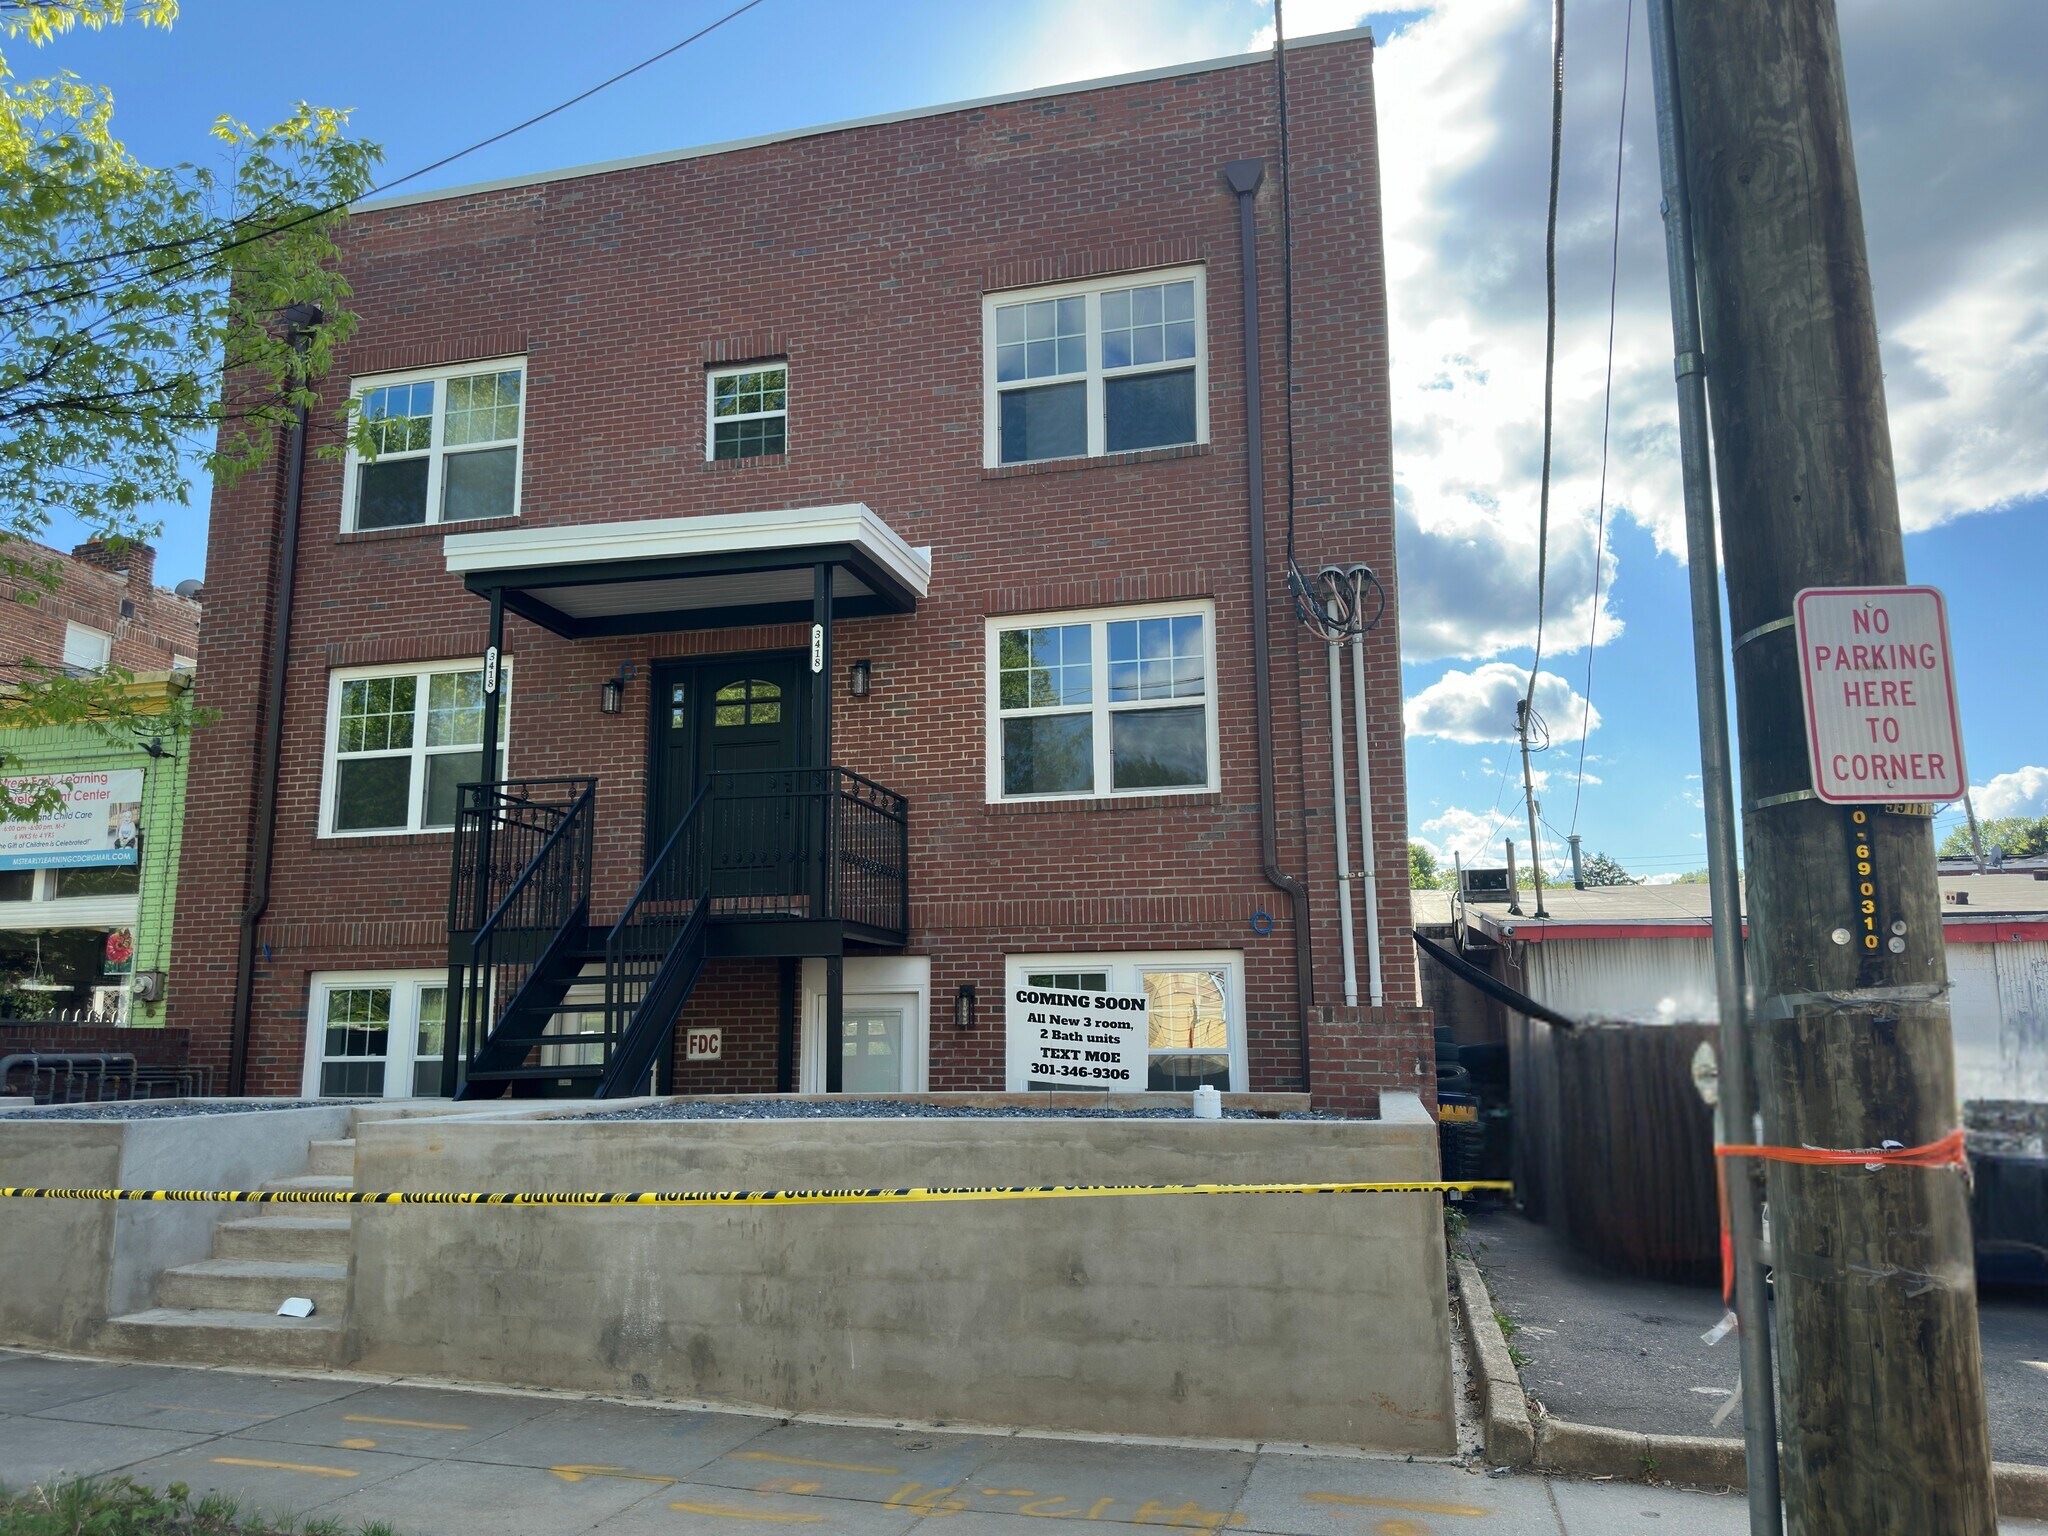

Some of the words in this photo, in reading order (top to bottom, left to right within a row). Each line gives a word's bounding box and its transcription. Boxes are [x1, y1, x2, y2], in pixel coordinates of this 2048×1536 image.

[1852, 608, 1890, 634] NO
[1815, 643, 1936, 671] PARKING
[1843, 680, 1917, 707] HERE
[1865, 717, 1900, 744] TO
[1832, 753, 1946, 781] CORNER
[61, 772, 108, 785] Learning
[74, 789, 111, 801] Center
[53, 812, 73, 821] Child
[74, 811, 93, 820] Care
[26, 839, 49, 848] Children
[1016, 990, 1090, 1008] COMING
[1095, 996, 1146, 1011] SOON
[1027, 1012, 1046, 1024] All
[1049, 1014, 1080, 1026] New
[1084, 1017, 1092, 1027] 3
[1095, 1019, 1134, 1031] room,
[690, 1034, 718, 1054] FDC
[1040, 1029, 1049, 1039] 2
[1051, 1030, 1083, 1042] Bath
[1086, 1033, 1121, 1044] units
[1040, 1047, 1081, 1061] TEXT
[1084, 1050, 1121, 1063] MOE
[1031, 1063, 1130, 1080] 301-346-9306
